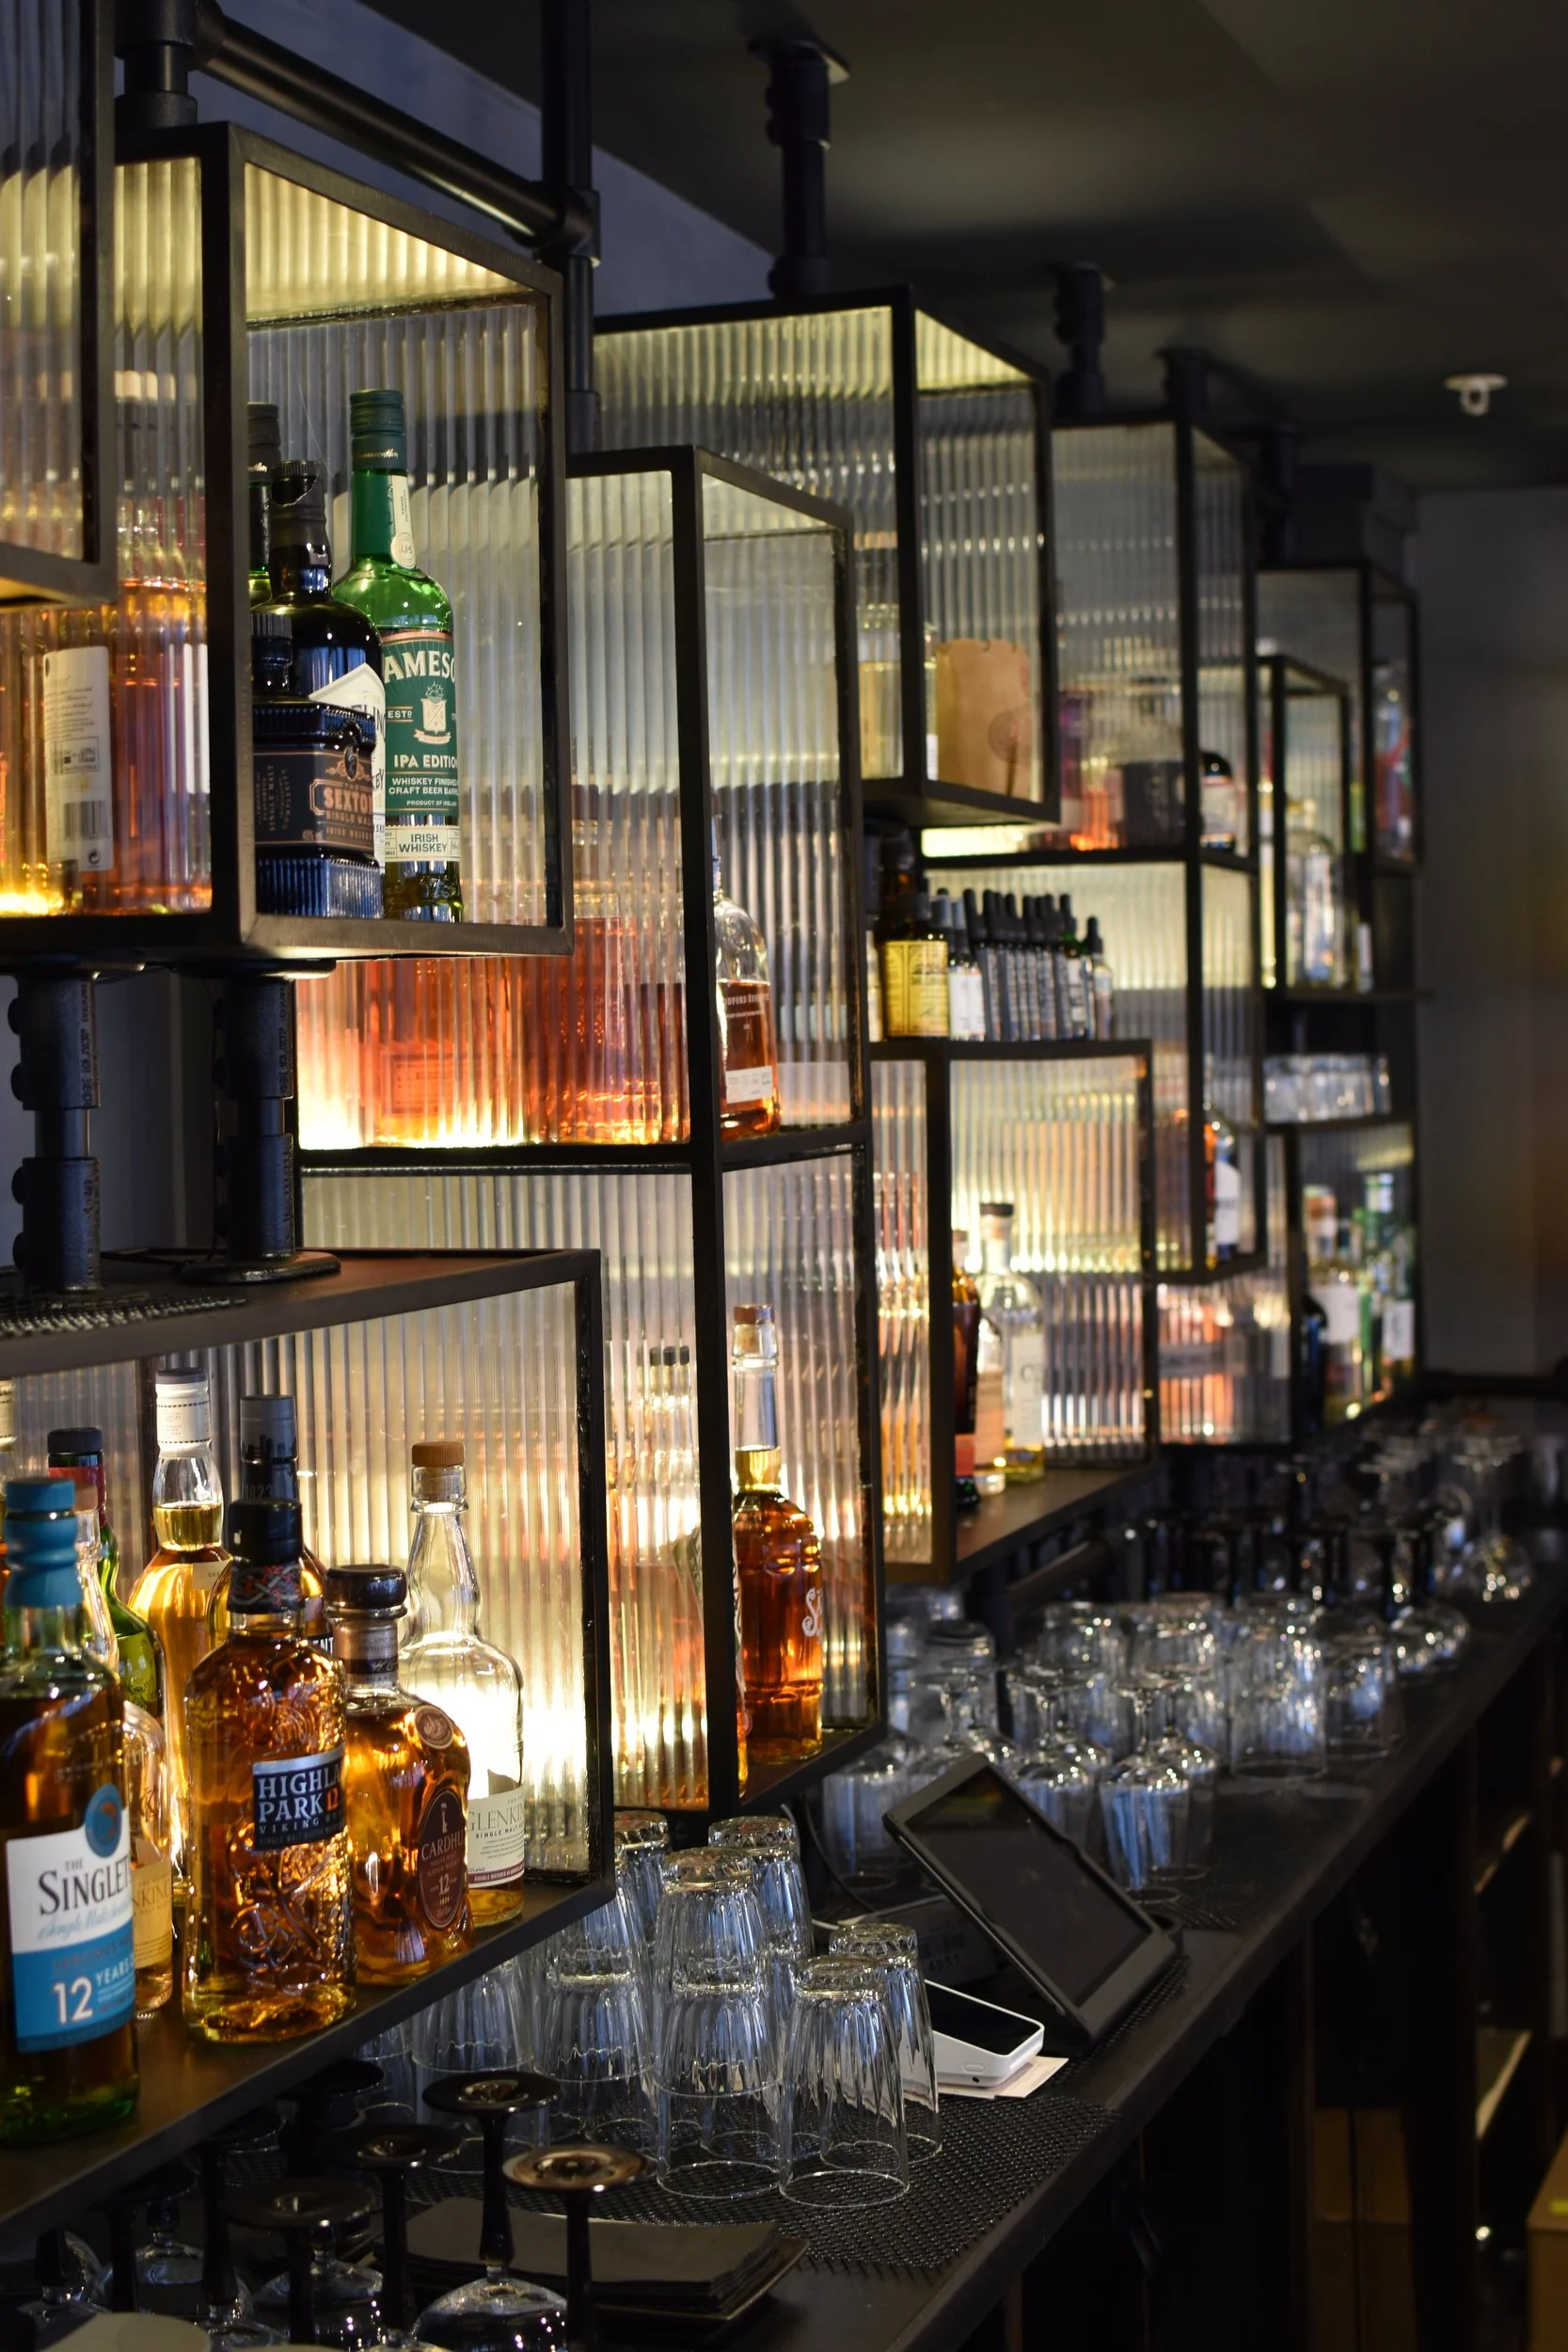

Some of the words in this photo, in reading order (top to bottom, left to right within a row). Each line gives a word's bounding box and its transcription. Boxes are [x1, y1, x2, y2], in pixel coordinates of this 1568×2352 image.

[393, 755, 419, 769] IPA
[422, 755, 458, 770] EDITIO
[388, 787, 420, 796] CRAFT
[422, 787, 443, 796] BEER
[391, 777, 434, 787] WHISKEY
[399, 843, 447, 853] WHISKEY
[410, 833, 438, 843] IRISH
[258, 1764, 341, 1800] HIGHLA
[259, 1792, 324, 1823] PARK
[475, 1829, 502, 1839] SINGLE
[420, 1828, 465, 1861] CARDHU
[38, 1853, 132, 1916] SINGLET
[438, 1872, 451, 1897] 12
[53, 1976, 94, 2025] 12
